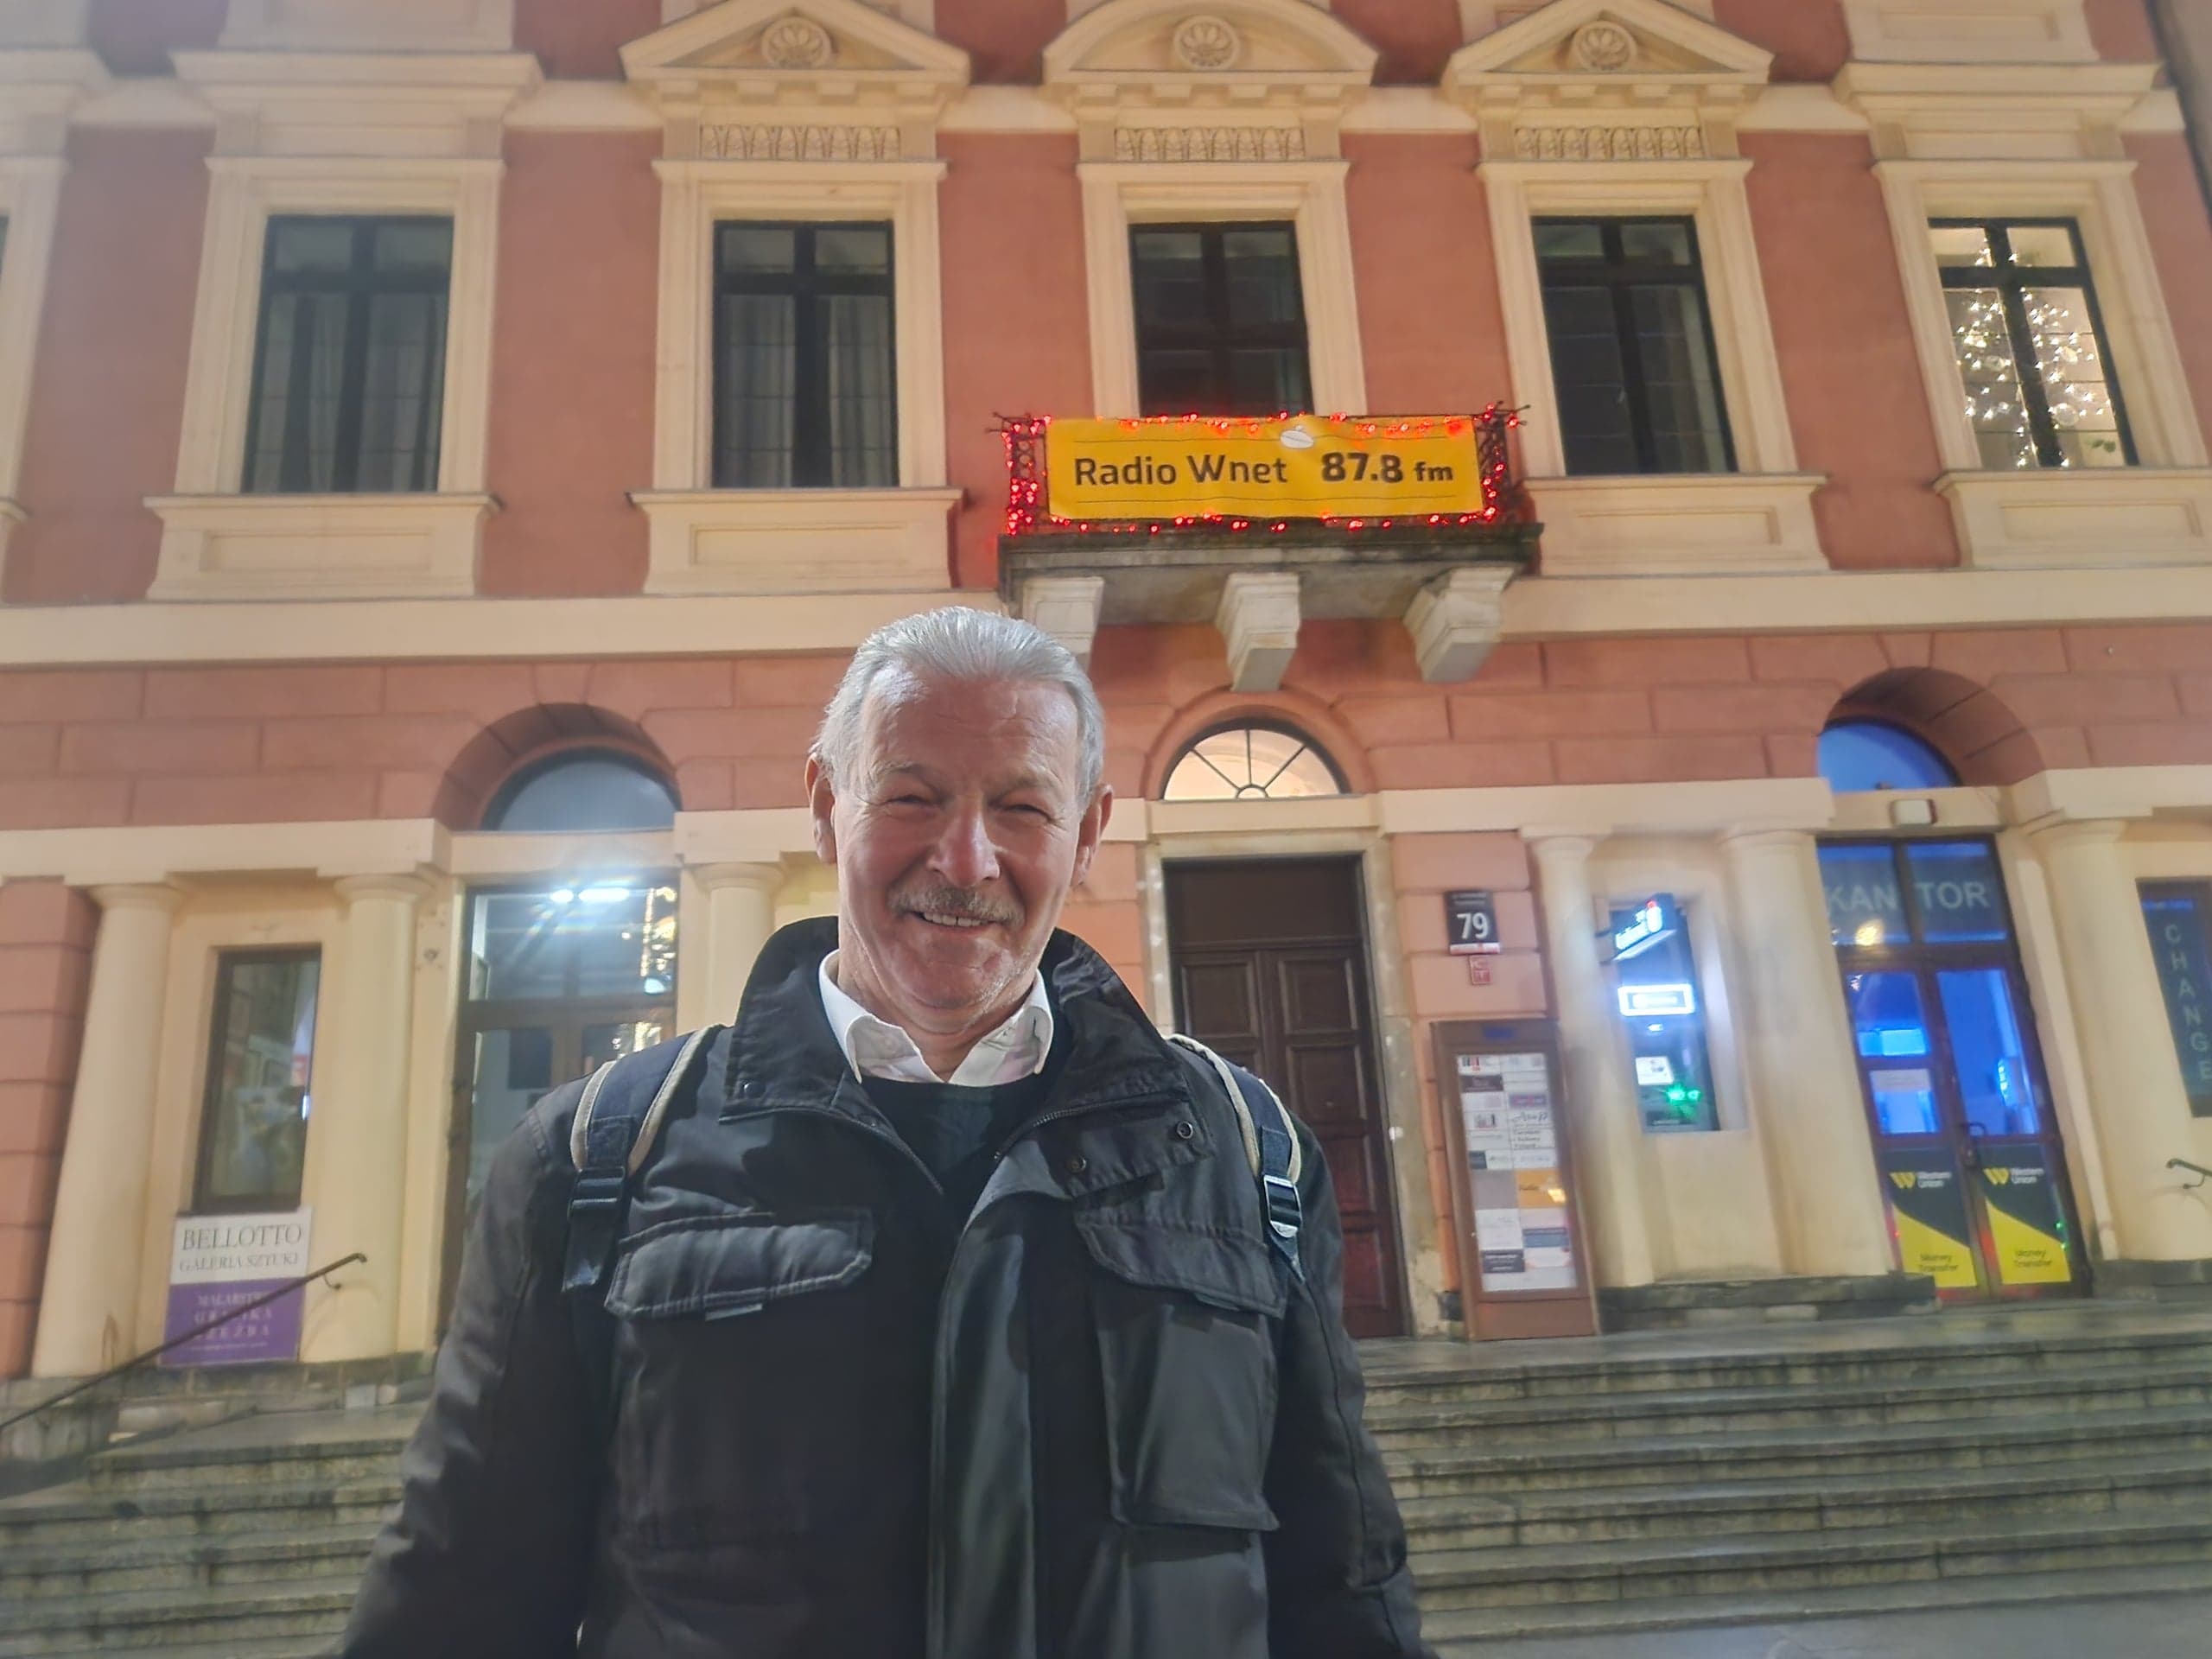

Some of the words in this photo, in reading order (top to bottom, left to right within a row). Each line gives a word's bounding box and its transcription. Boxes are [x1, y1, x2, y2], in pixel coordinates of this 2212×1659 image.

[1074, 454, 1176, 486] Radio
[1187, 454, 1287, 484] Wnet
[1320, 451, 1404, 483] 87.8
[1414, 461, 1453, 481] fm
[1456, 912, 1488, 939] 79
[182, 1223, 302, 1250] BELLOTTO
[179, 1255, 243, 1273] GALERIA
